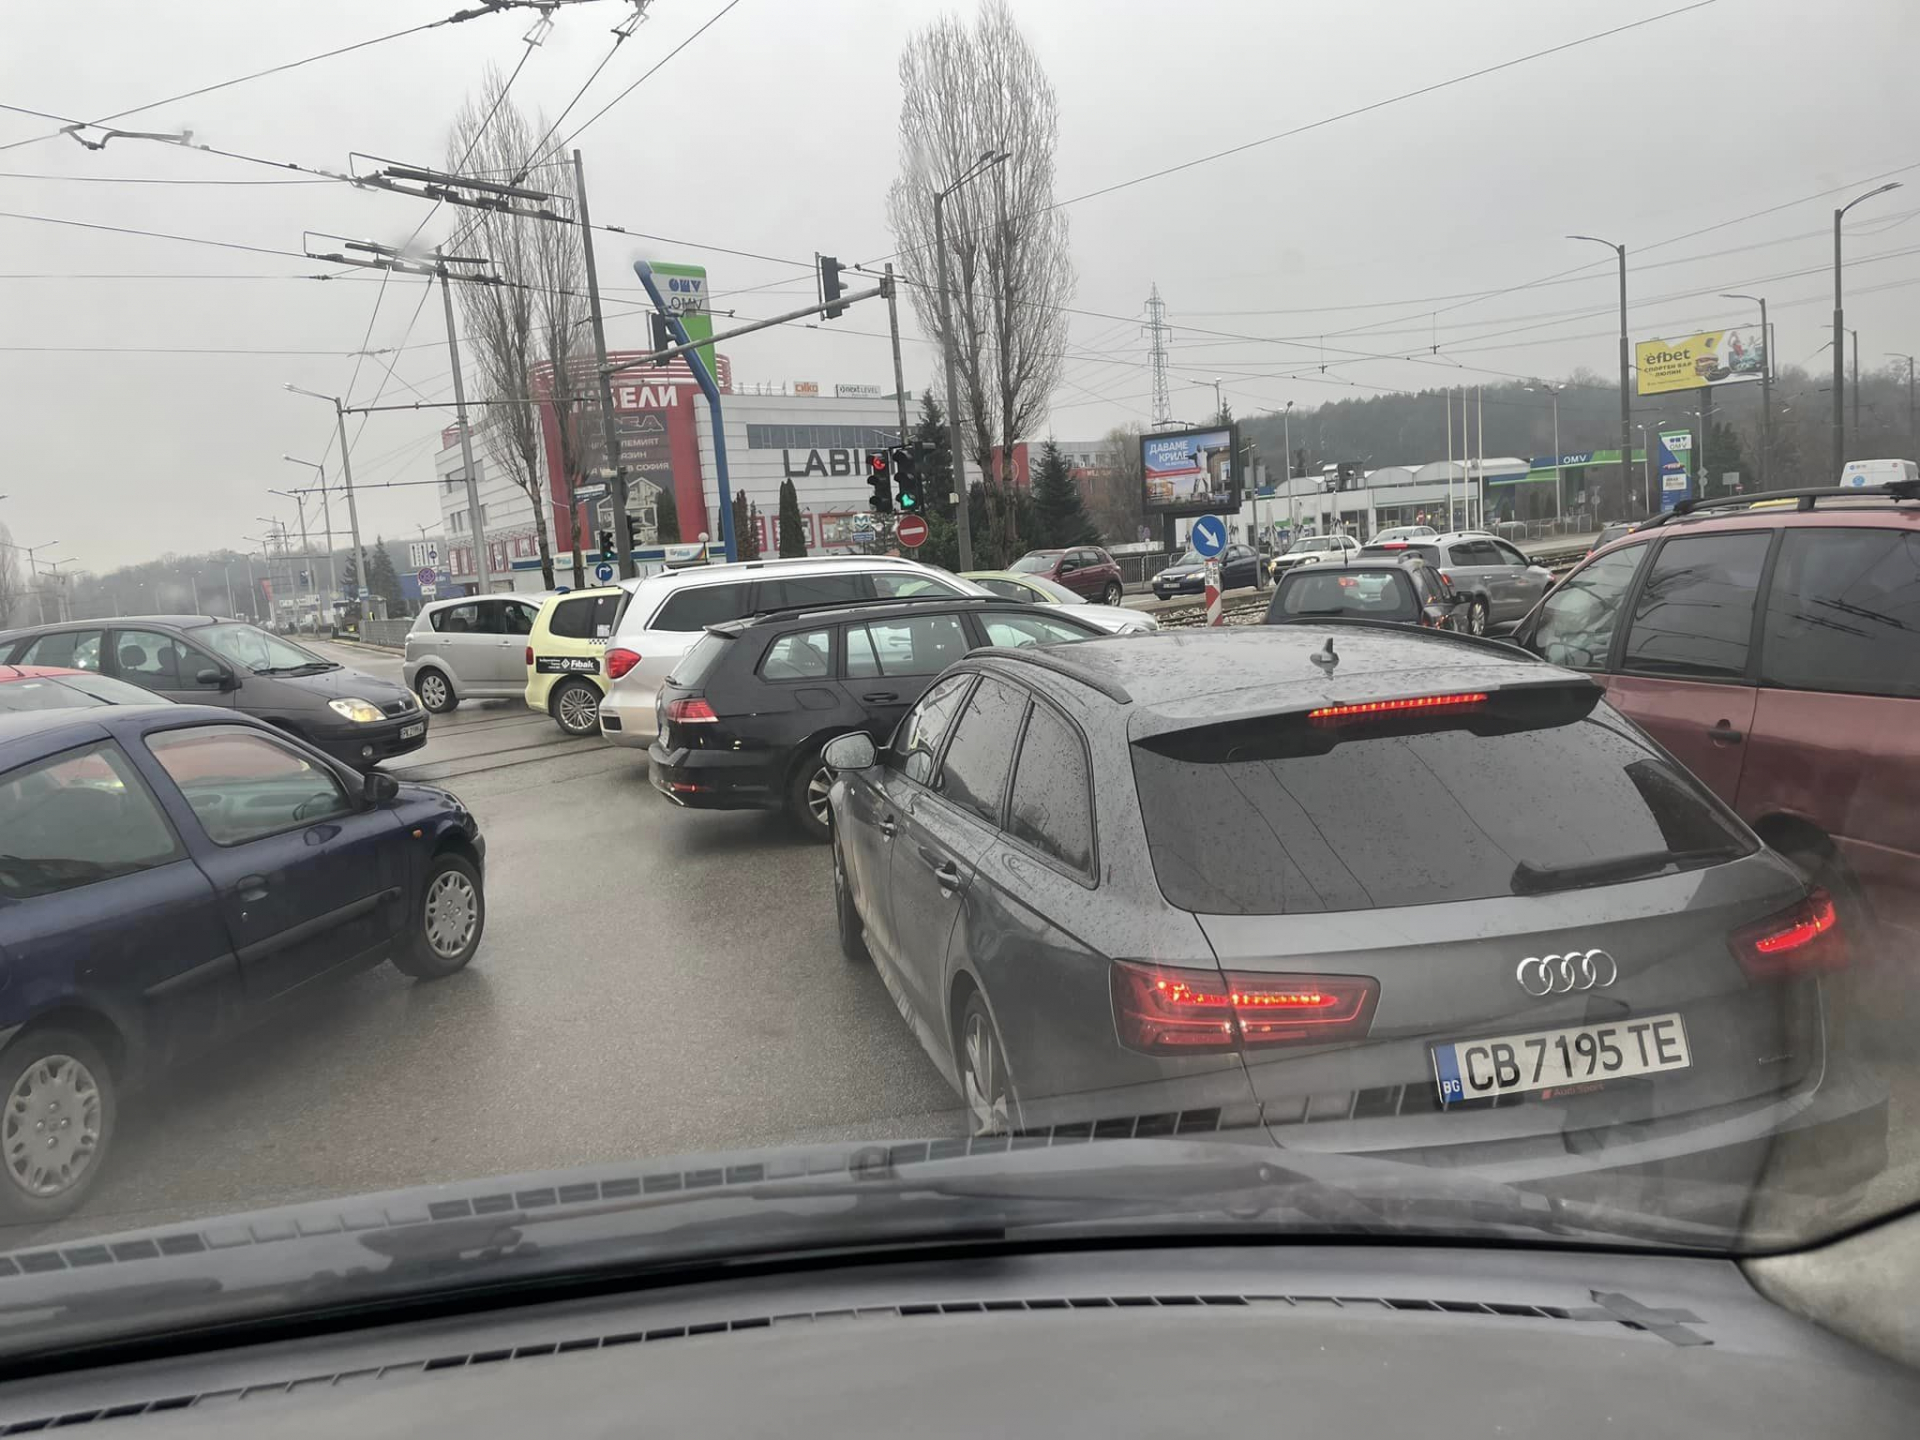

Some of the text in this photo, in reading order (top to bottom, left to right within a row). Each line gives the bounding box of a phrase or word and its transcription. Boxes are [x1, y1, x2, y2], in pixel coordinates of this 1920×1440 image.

[671, 296, 702, 310] OMV
[1645, 349, 1690, 365] efbet
[1149, 440, 1189, 455] ДАВАМЕ
[1158, 450, 1189, 463] КРИЛЕ
[1563, 454, 1587, 464] OMV
[636, 462, 670, 472] СОФИЯ
[1443, 1078, 1460, 1094] BG
